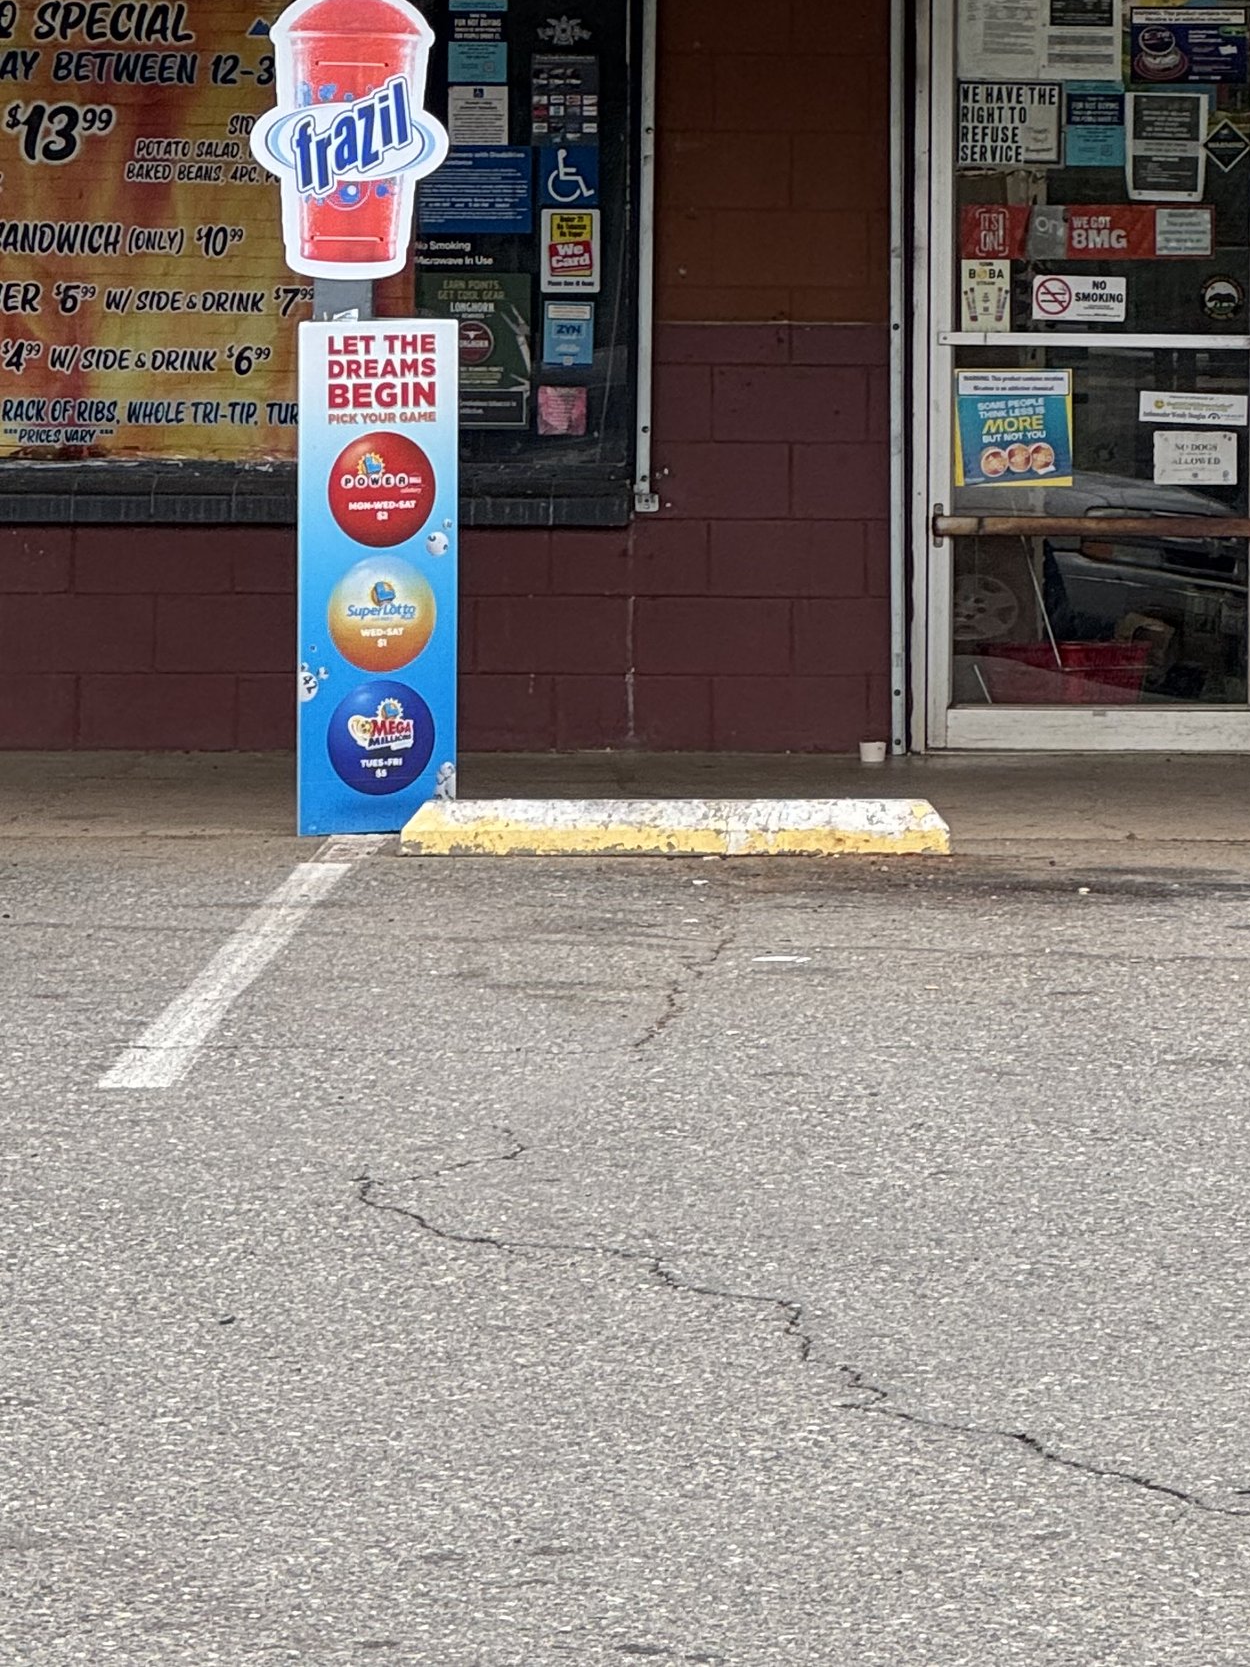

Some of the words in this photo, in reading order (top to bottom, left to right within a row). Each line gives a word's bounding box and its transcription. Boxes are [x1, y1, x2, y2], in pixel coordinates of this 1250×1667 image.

[34, 1, 195, 42] SPECIAL
[53, 51, 198, 84] BETWEEN
[961, 85, 980, 103] WE
[985, 85, 1023, 104] HAVE
[1028, 86, 1056, 105] THE
[961, 105, 1005, 124] RIGHT
[1009, 105, 1027, 124] TO
[296, 78, 411, 193] frazil
[961, 125, 1020, 144] REFUSE
[136, 140, 190, 158] POTATO
[961, 144, 1023, 163] SERVICE
[126, 164, 171, 181] BAKED
[177, 165, 224, 184] BEANS,
[1072, 216, 1091, 228] WE
[1092, 215, 1112, 228] GOT
[128, 227, 185, 254] (ONLY)
[430, 240, 471, 252] Smoking
[1072, 228, 1127, 249] 8MG
[556, 243, 584, 256] We
[415, 256, 464, 265] Microwave
[465, 256, 474, 265] In
[475, 256, 493, 266] Use
[551, 253, 591, 269] Card
[1091, 279, 1107, 290] NO
[136, 290, 184, 312] SIDE
[186, 293, 197, 309] &
[201, 292, 265, 313] DRINK
[1074, 291, 1125, 304] SMOKING
[450, 302, 495, 313] LONGHORN
[556, 324, 581, 334] ZYN
[328, 335, 376, 356] LET
[383, 333, 436, 354] THE
[82, 348, 132, 370] SIDE
[135, 351, 146, 368] &
[152, 349, 217, 372] DRINK
[328, 358, 437, 380] DREAMS
[328, 381, 437, 409] BEGIN
[977, 401, 1006, 411] SOME
[1007, 397, 1045, 408] PEOPLE
[2, 399, 46, 422] RACK
[51, 400, 69, 423] OF
[127, 401, 186, 424] WHOLE
[328, 413, 358, 425] PICK
[360, 412, 396, 424] YOUR
[399, 411, 437, 423] GAME
[978, 409, 1008, 419] THINK
[1009, 407, 1034, 416] LESS
[1035, 406, 1046, 414] IS
[982, 415, 1044, 434] MORE
[982, 434, 1002, 443] BUT
[1003, 431, 1023, 441] NOT
[1025, 430, 1046, 438] YOU
[1190, 443, 1218, 452] DOGS
[1174, 457, 1221, 465] ALLOWED
[370, 720, 412, 737] MEGA
